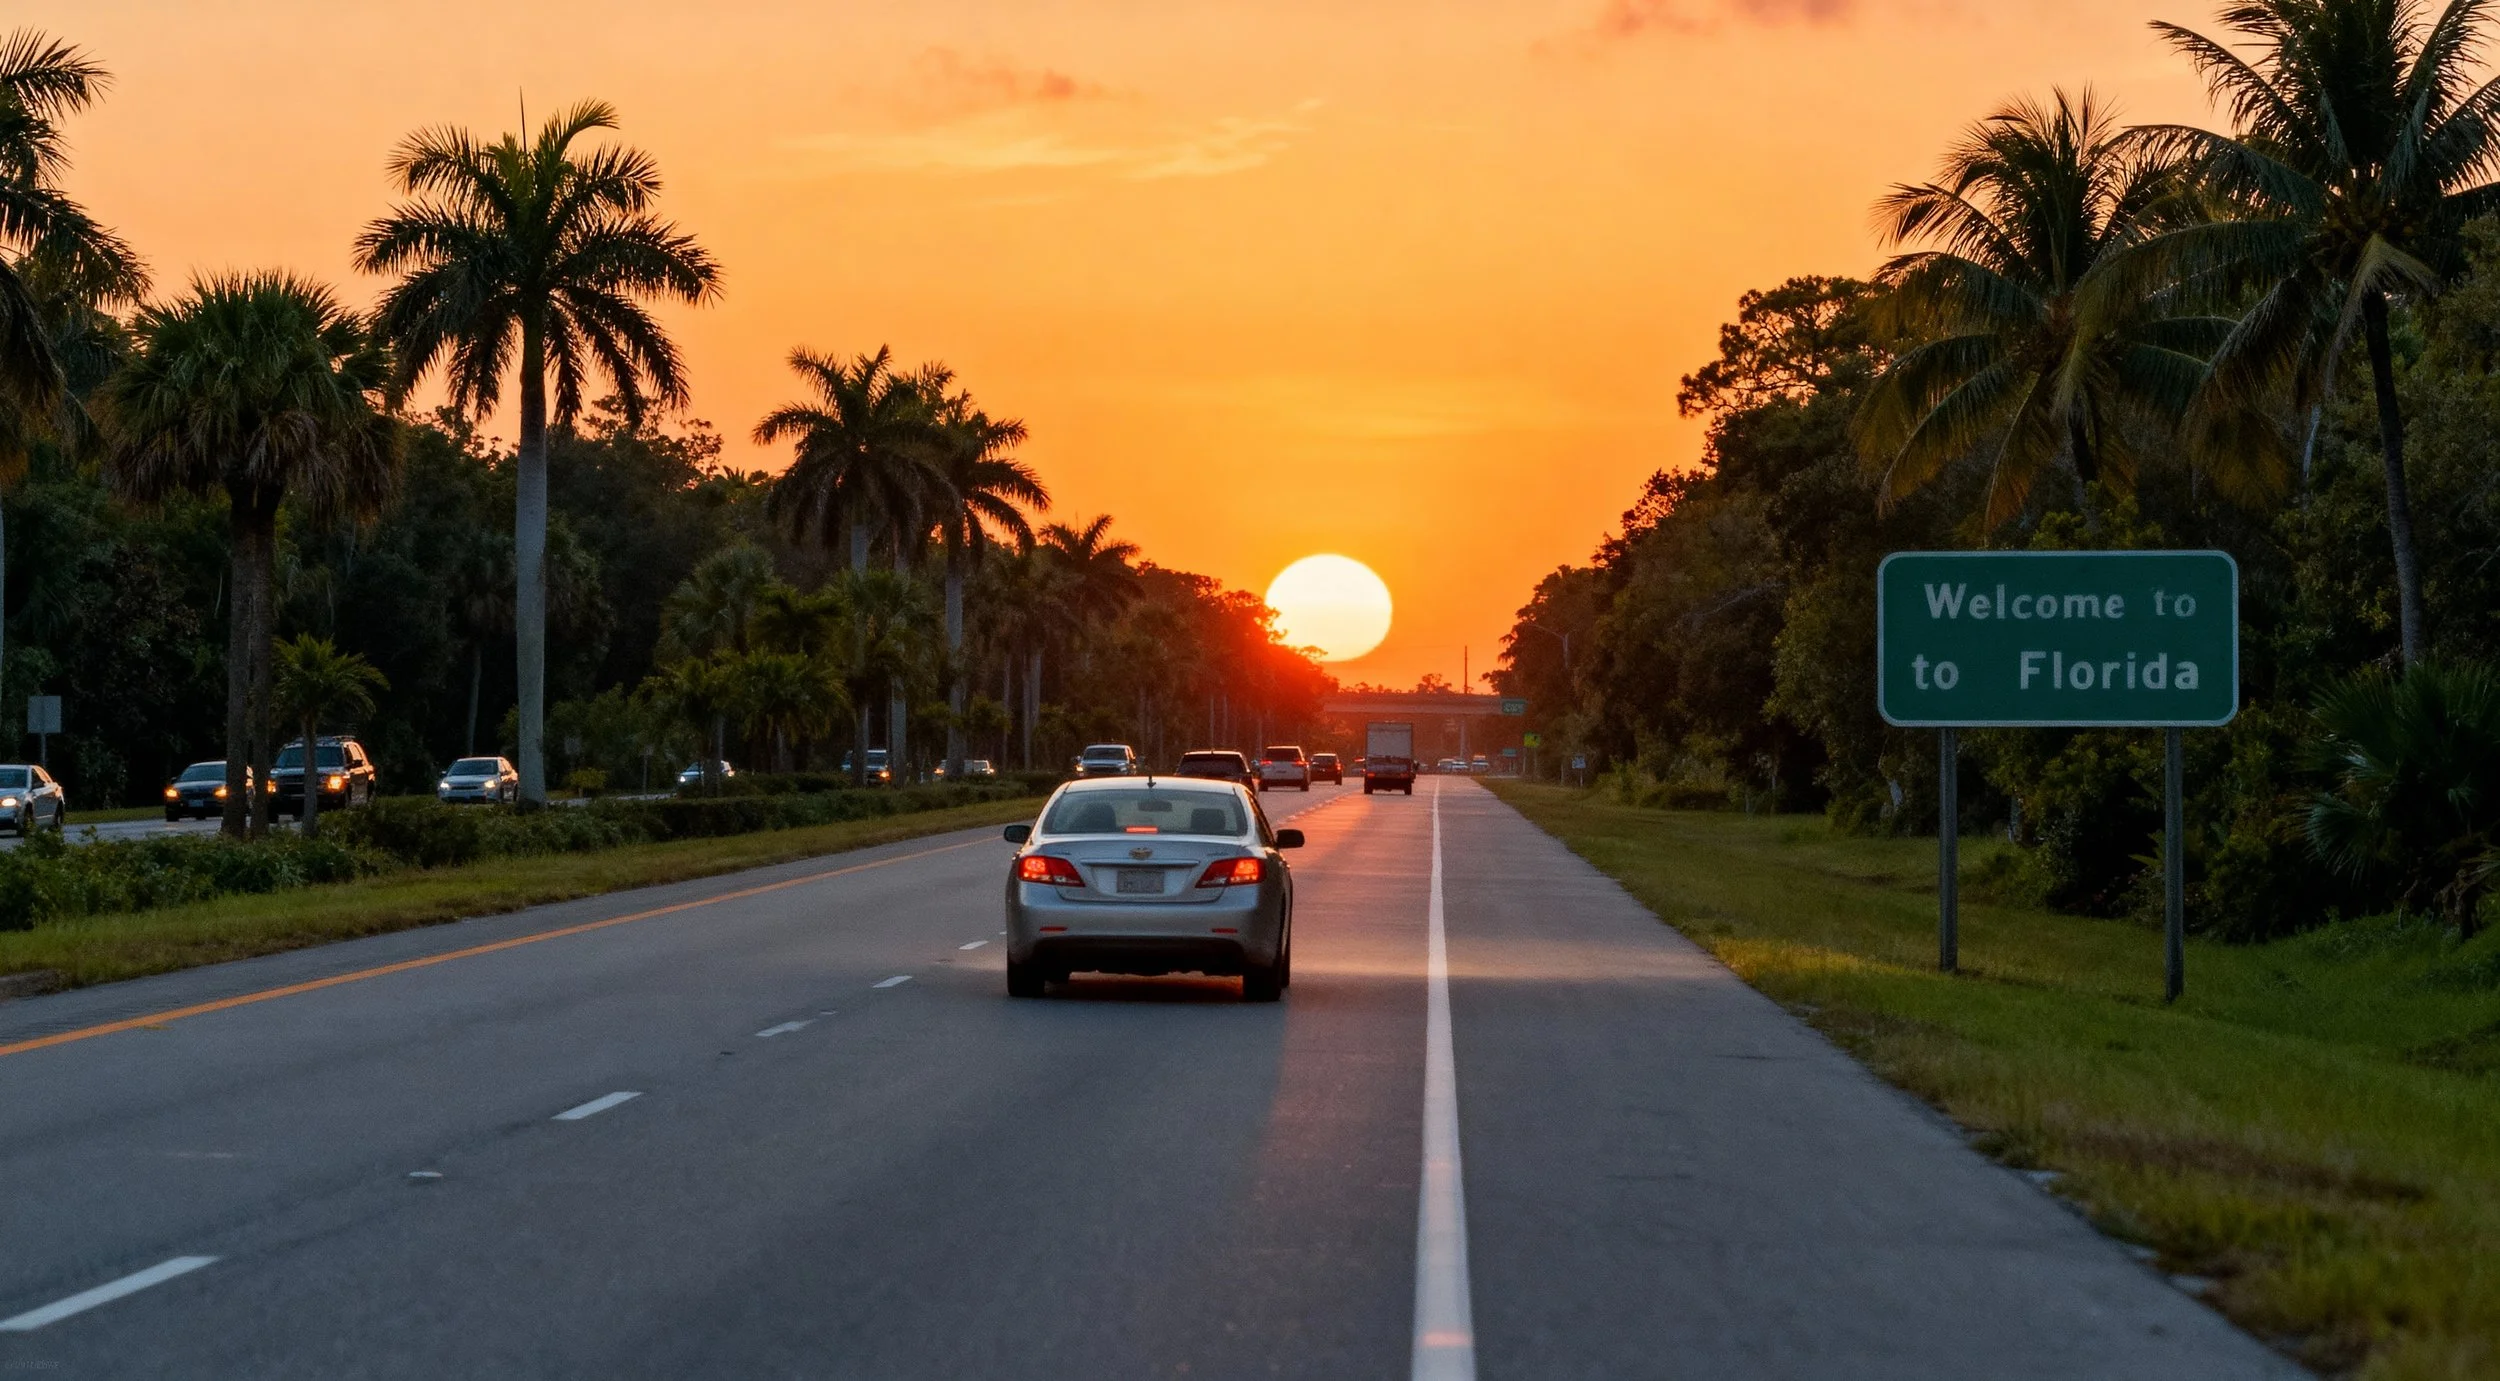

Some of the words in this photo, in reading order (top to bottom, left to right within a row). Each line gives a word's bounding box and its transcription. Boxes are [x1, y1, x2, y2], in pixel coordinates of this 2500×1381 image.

[1924, 583, 2125, 619] Welcome
[2153, 590, 2197, 617] to
[1911, 654, 1959, 690] to
[2020, 651, 2199, 690] Florida
